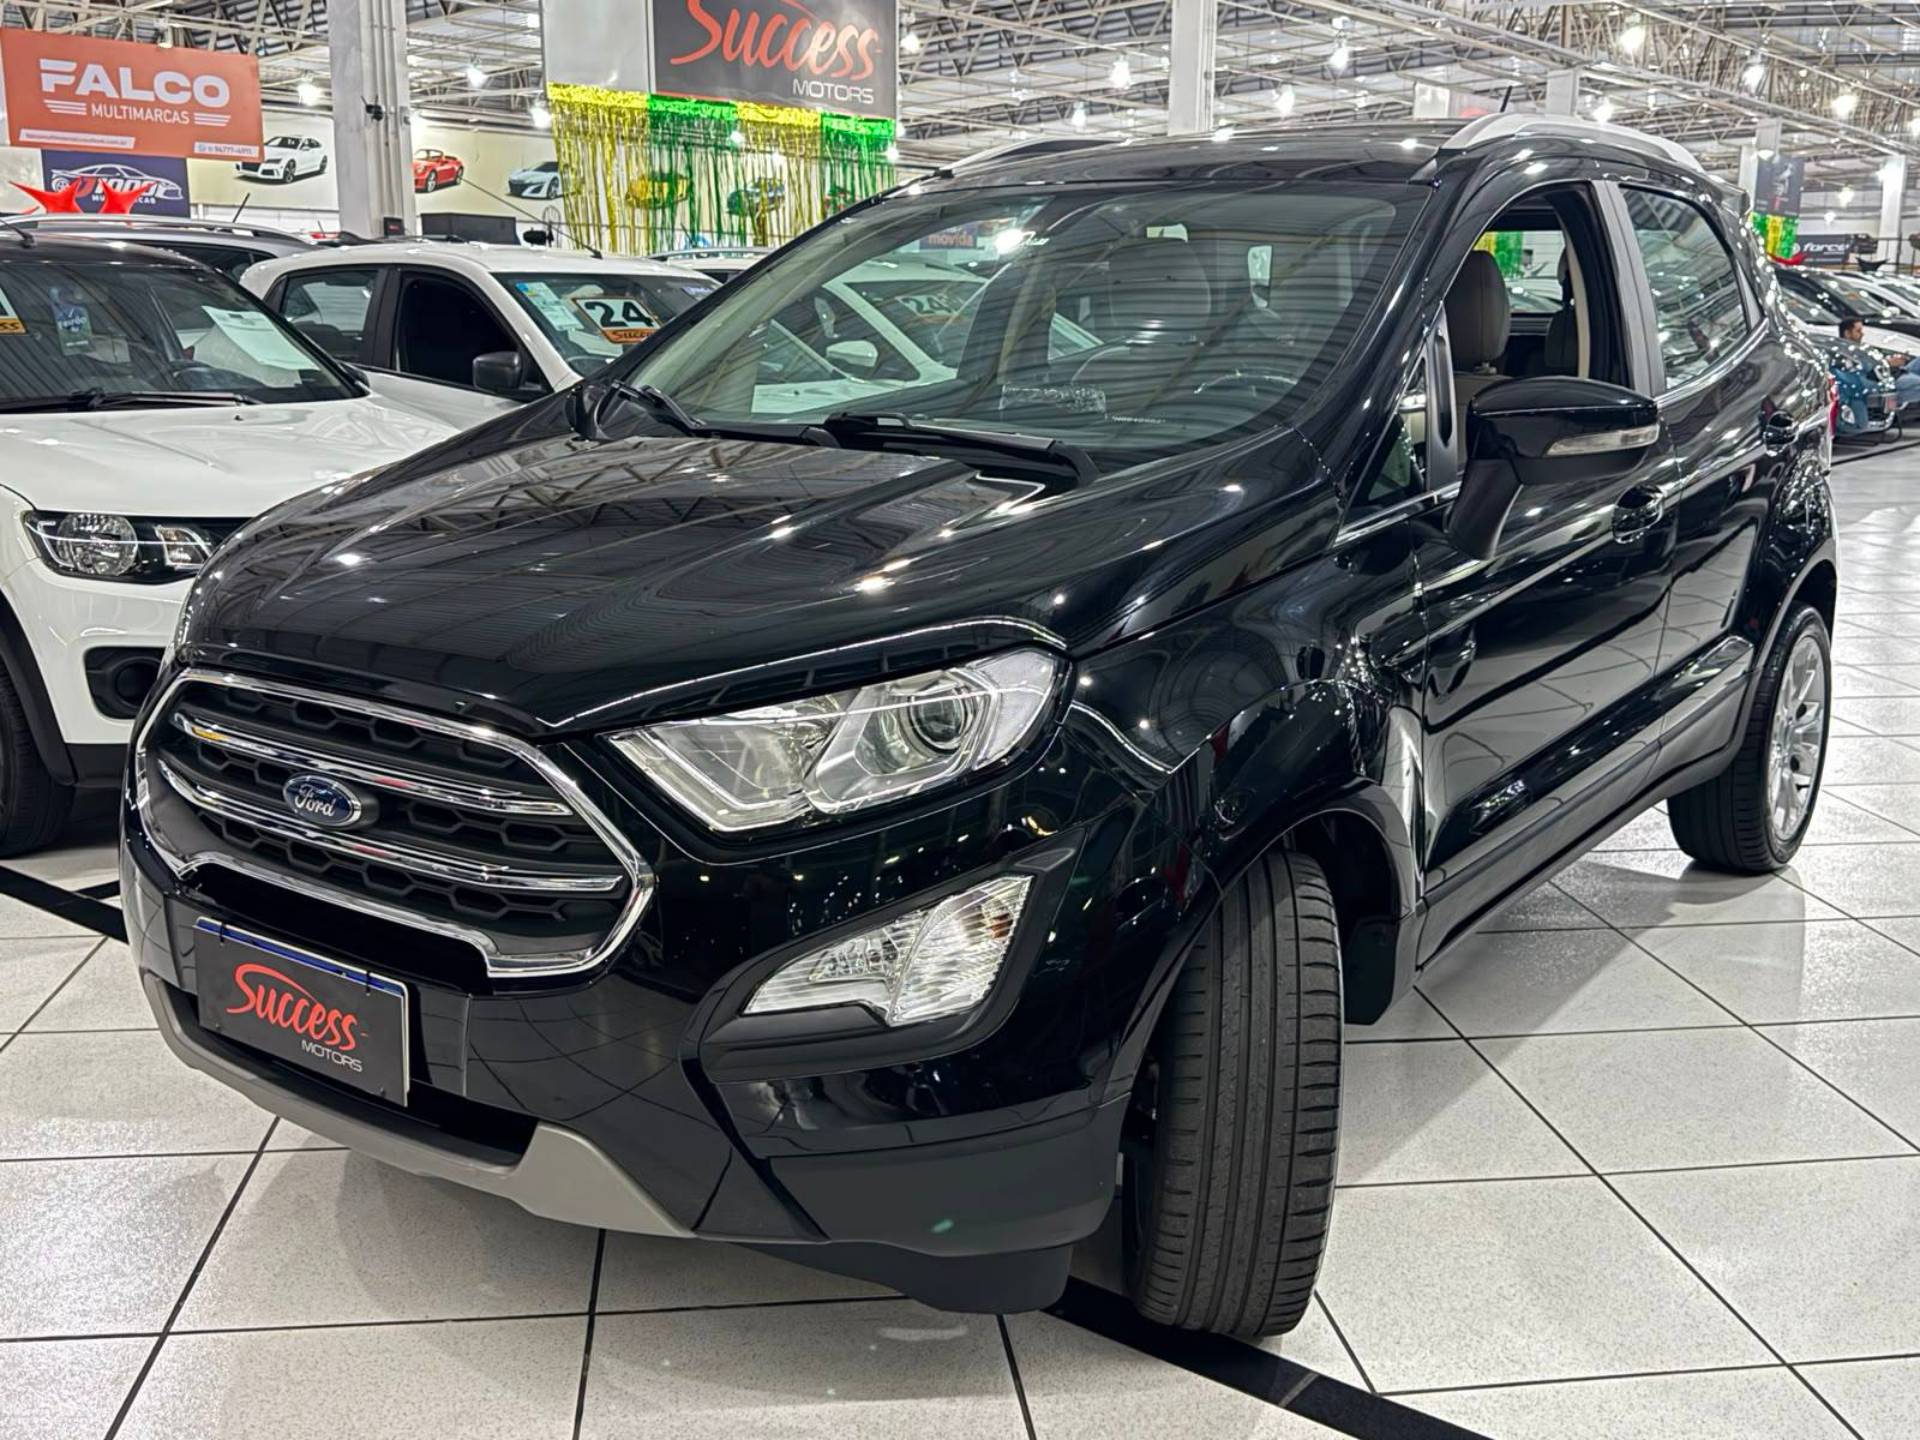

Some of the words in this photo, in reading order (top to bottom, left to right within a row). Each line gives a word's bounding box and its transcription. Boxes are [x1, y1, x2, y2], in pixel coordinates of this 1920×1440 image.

[40, 58, 230, 108] FALCO
[793, 78, 874, 104] MOTORS
[91, 104, 190, 125] MULTIMARCAS
[585, 301, 654, 327] 24
[294, 783, 337, 817] Ford
[226, 963, 358, 1050] Success
[301, 1039, 363, 1072] MOTORS
